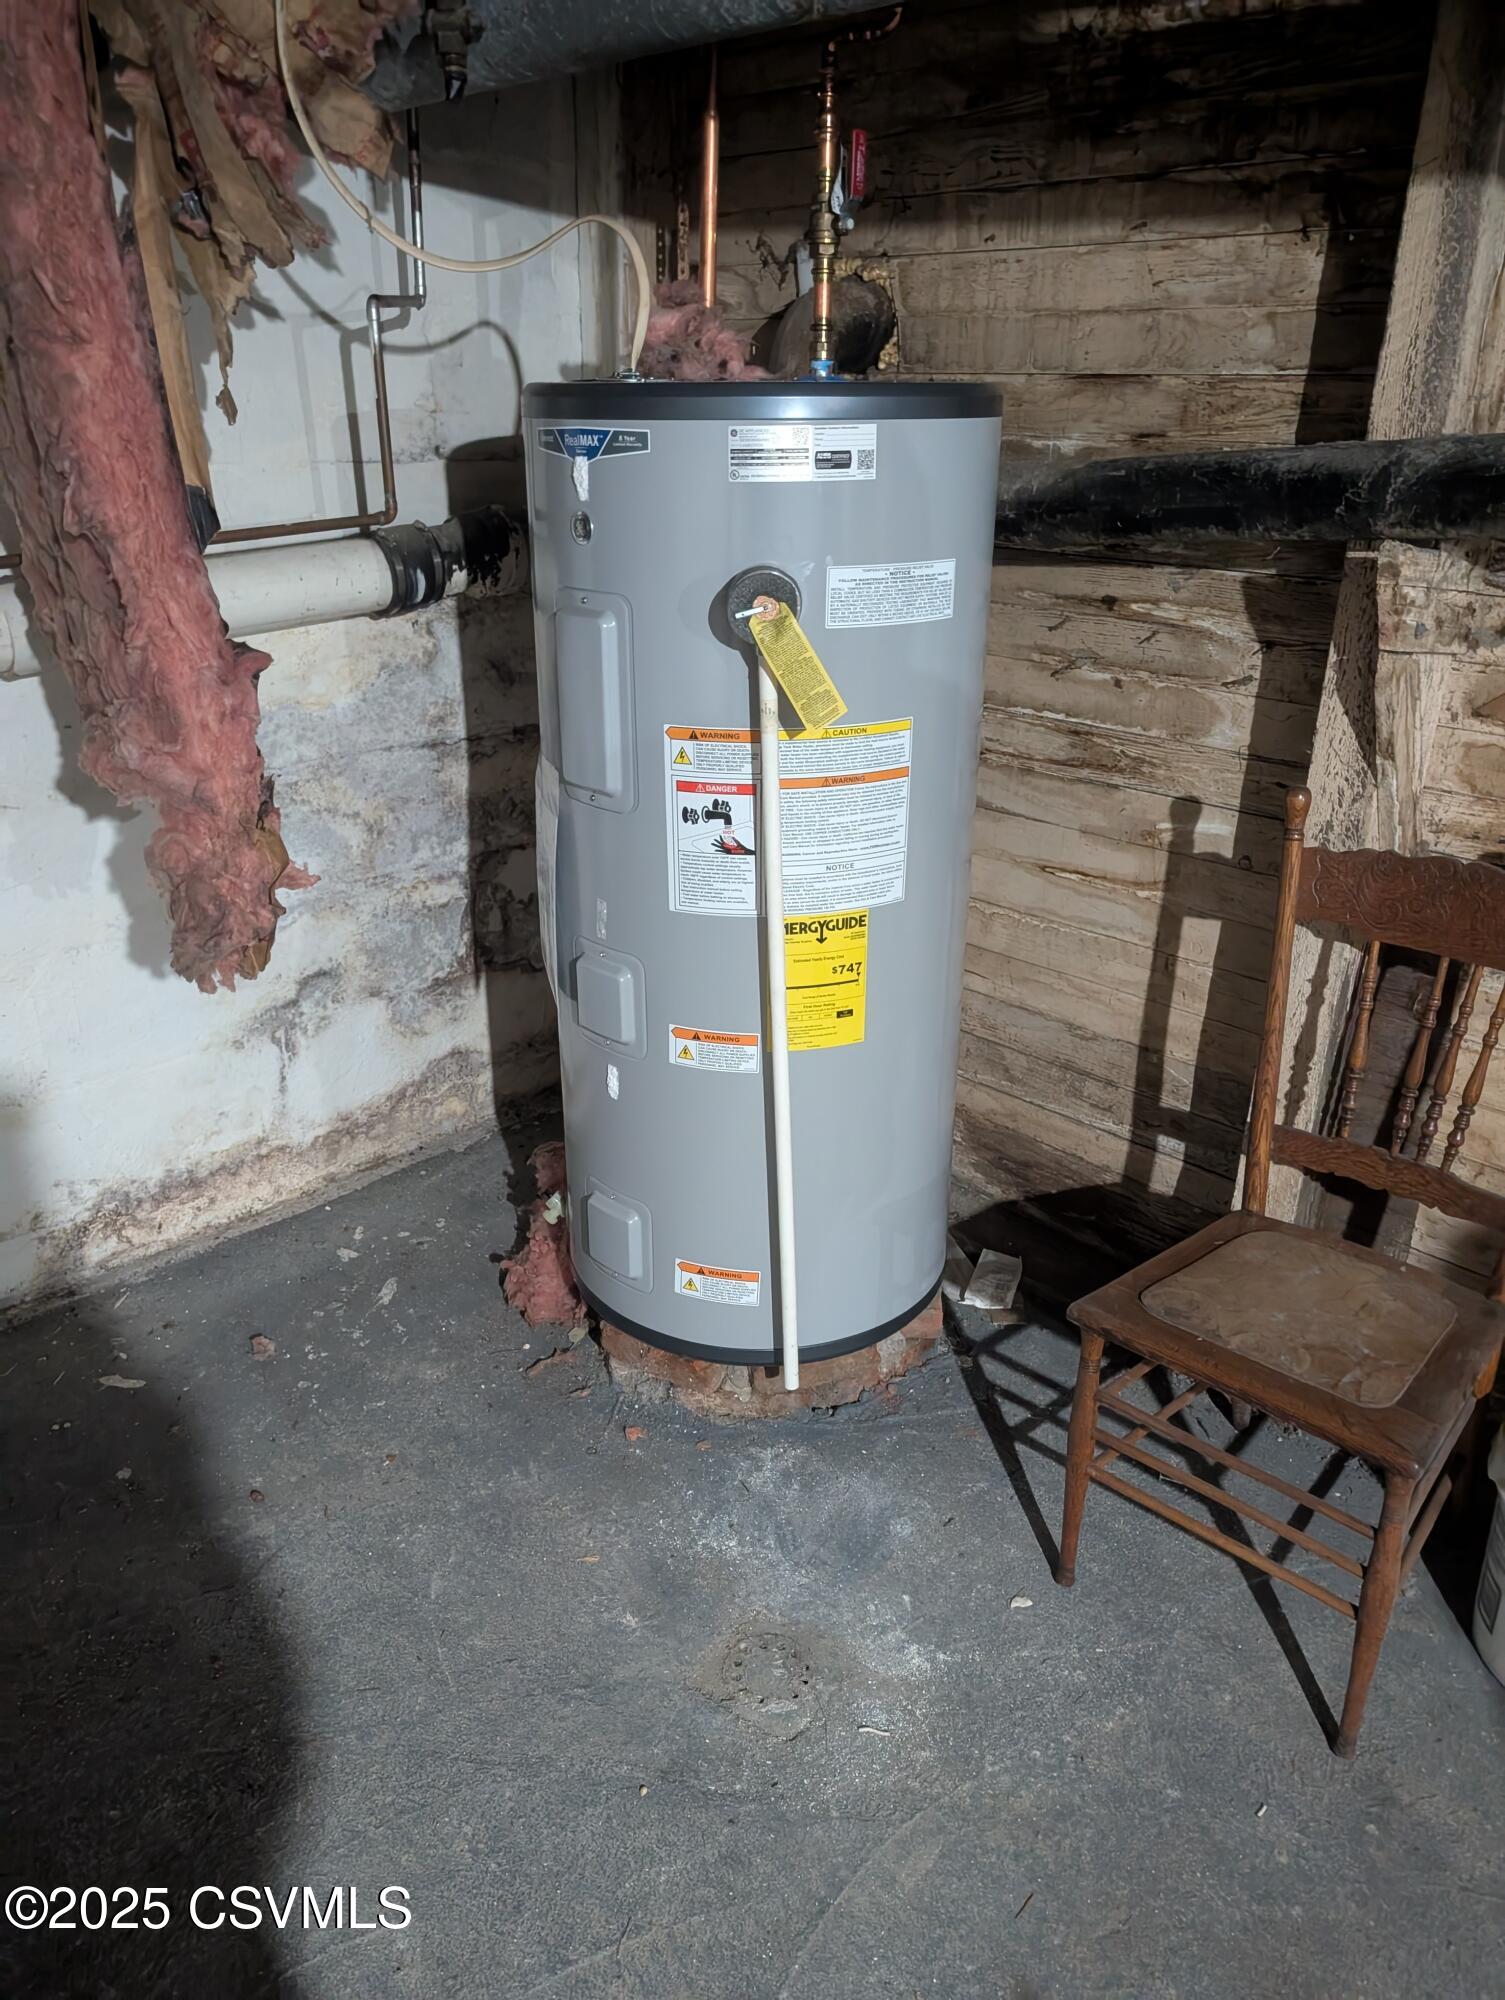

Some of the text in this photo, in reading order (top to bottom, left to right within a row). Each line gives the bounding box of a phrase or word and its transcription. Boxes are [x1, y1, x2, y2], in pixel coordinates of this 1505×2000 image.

[700, 731, 740, 740] WARNING
[832, 727, 868, 737] CAUTION
[831, 775, 866, 785] WARNING
[705, 784, 738, 793] DANGER
[826, 863, 855, 872] NOTICE
[832, 962, 862, 975] $747
[703, 1034, 740, 1043] WARNING
[707, 1270, 742, 1279] WARNING
